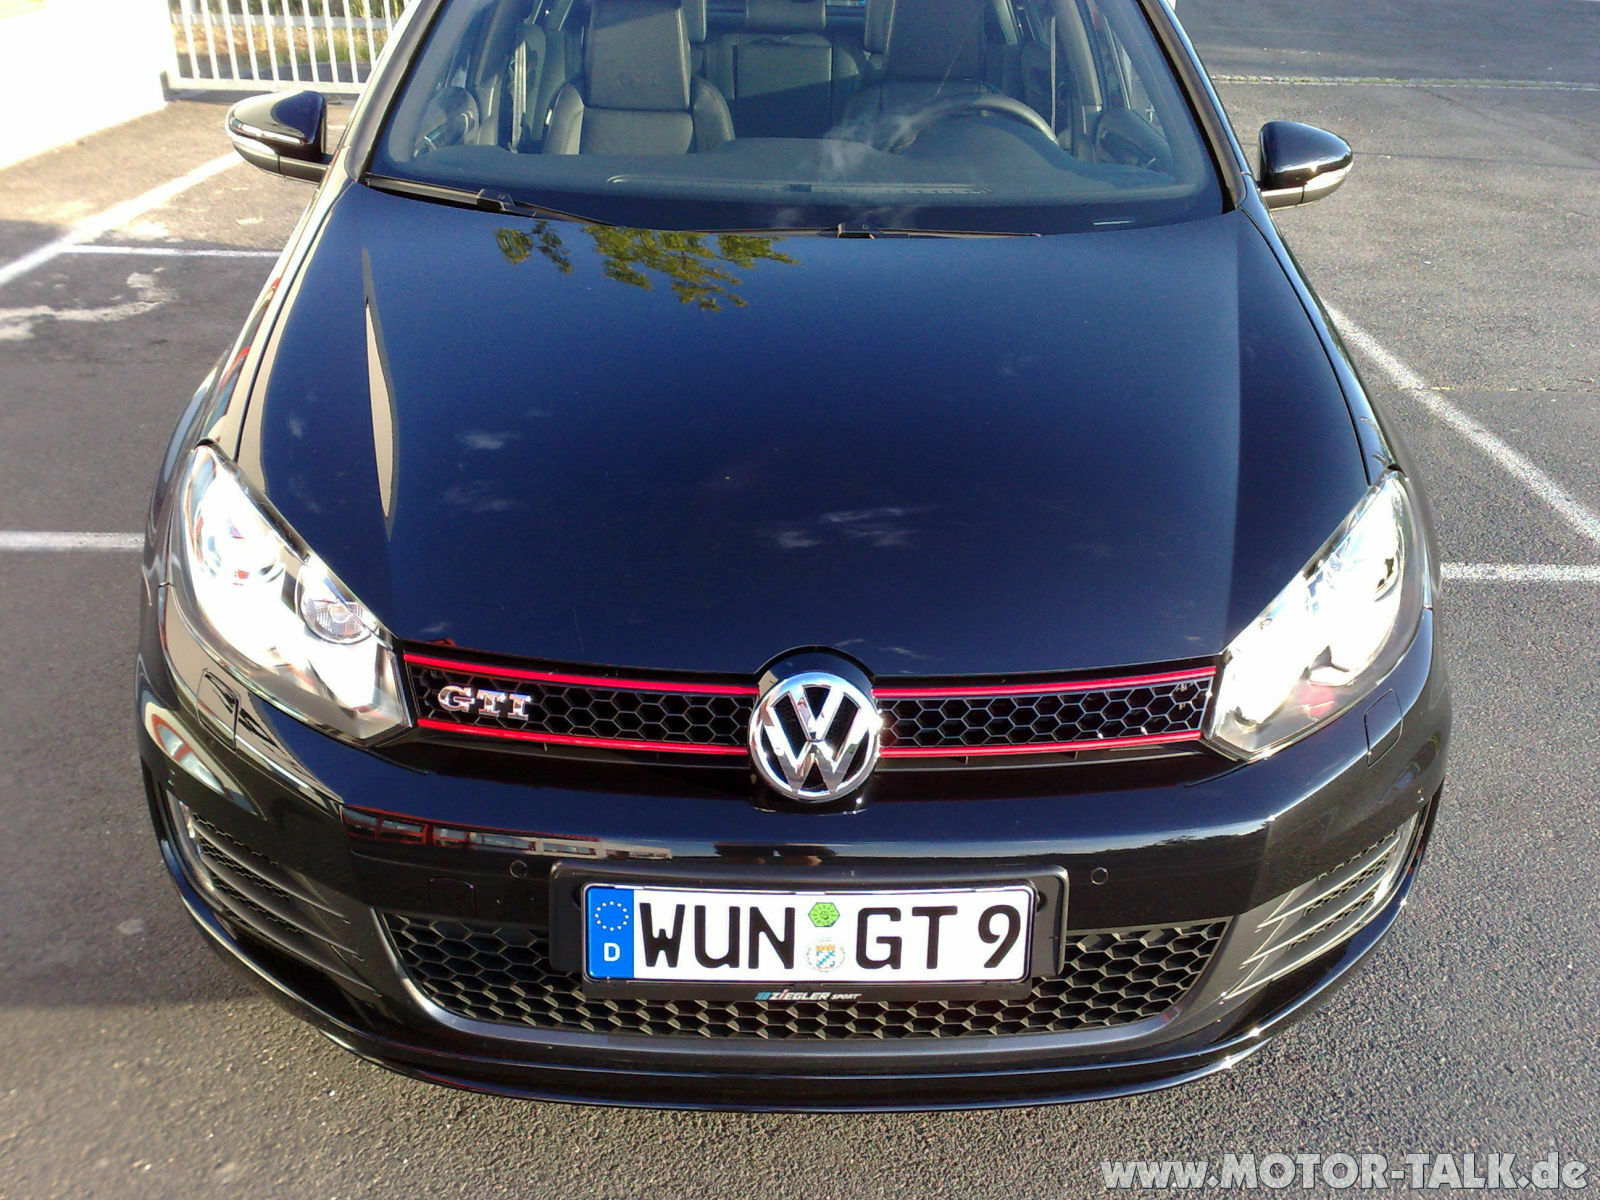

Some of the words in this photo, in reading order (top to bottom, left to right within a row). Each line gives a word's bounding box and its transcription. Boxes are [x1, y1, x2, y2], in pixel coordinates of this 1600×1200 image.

[437, 685, 532, 720] GTI
[758, 678, 876, 799] VW
[603, 942, 621, 962] D
[639, 902, 795, 969] WUN
[855, 905, 958, 970] GT
[977, 905, 1022, 969] 9
